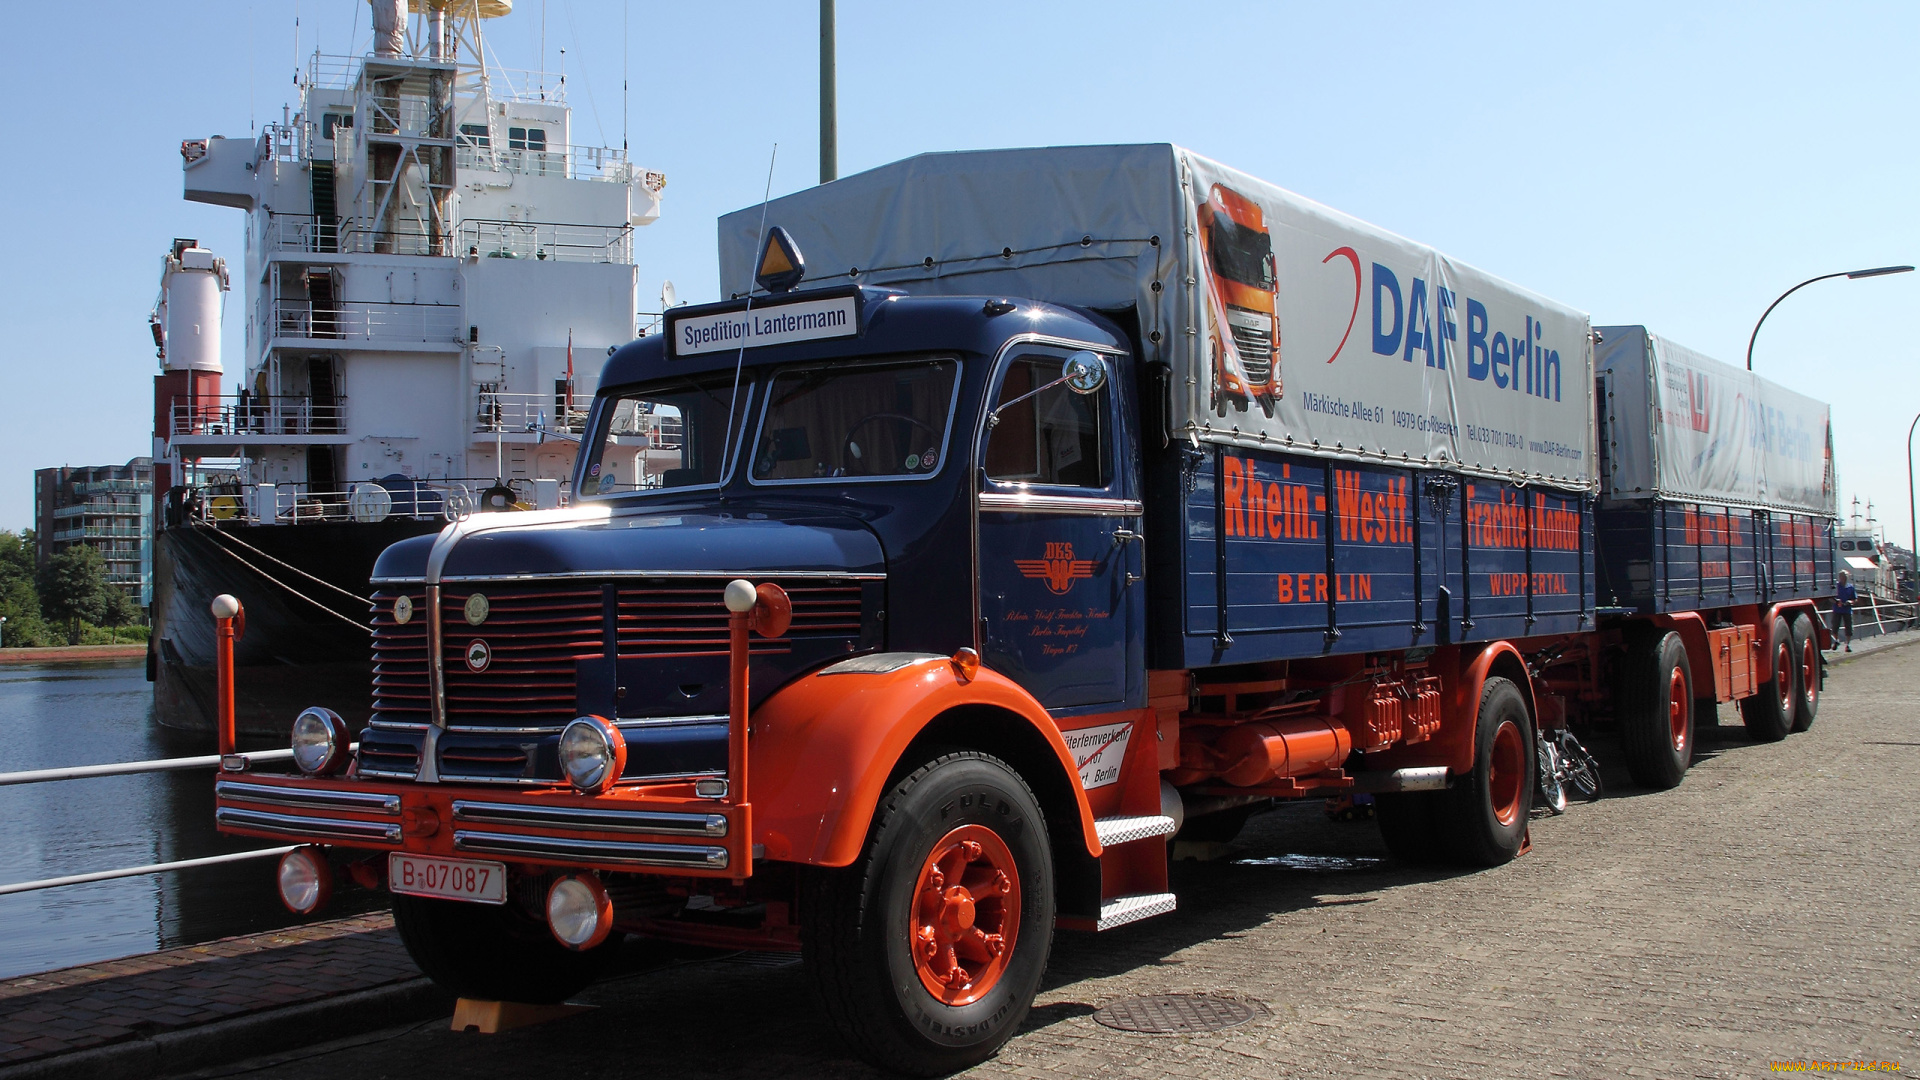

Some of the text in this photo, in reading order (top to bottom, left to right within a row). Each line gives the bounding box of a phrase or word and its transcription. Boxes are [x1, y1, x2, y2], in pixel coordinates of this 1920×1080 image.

[685, 309, 846, 348] Spedition Lantermann
[1244, 319, 1259, 327] DAF
[1372, 262, 1456, 370] DAF
[1467, 297, 1560, 402] Berlin
[1303, 391, 1349, 418] Märkische
[1352, 401, 1372, 422] Allee
[1374, 406, 1384, 424] 61
[1392, 410, 1415, 430] 14979
[1536, 493, 1580, 550] Kontor
[1045, 542, 1073, 560] DKS
[1278, 573, 1567, 603] BERLIN WUPPERTAL
[1094, 766, 1117, 783] Berlin
[940, 792, 1023, 838] FULDA
